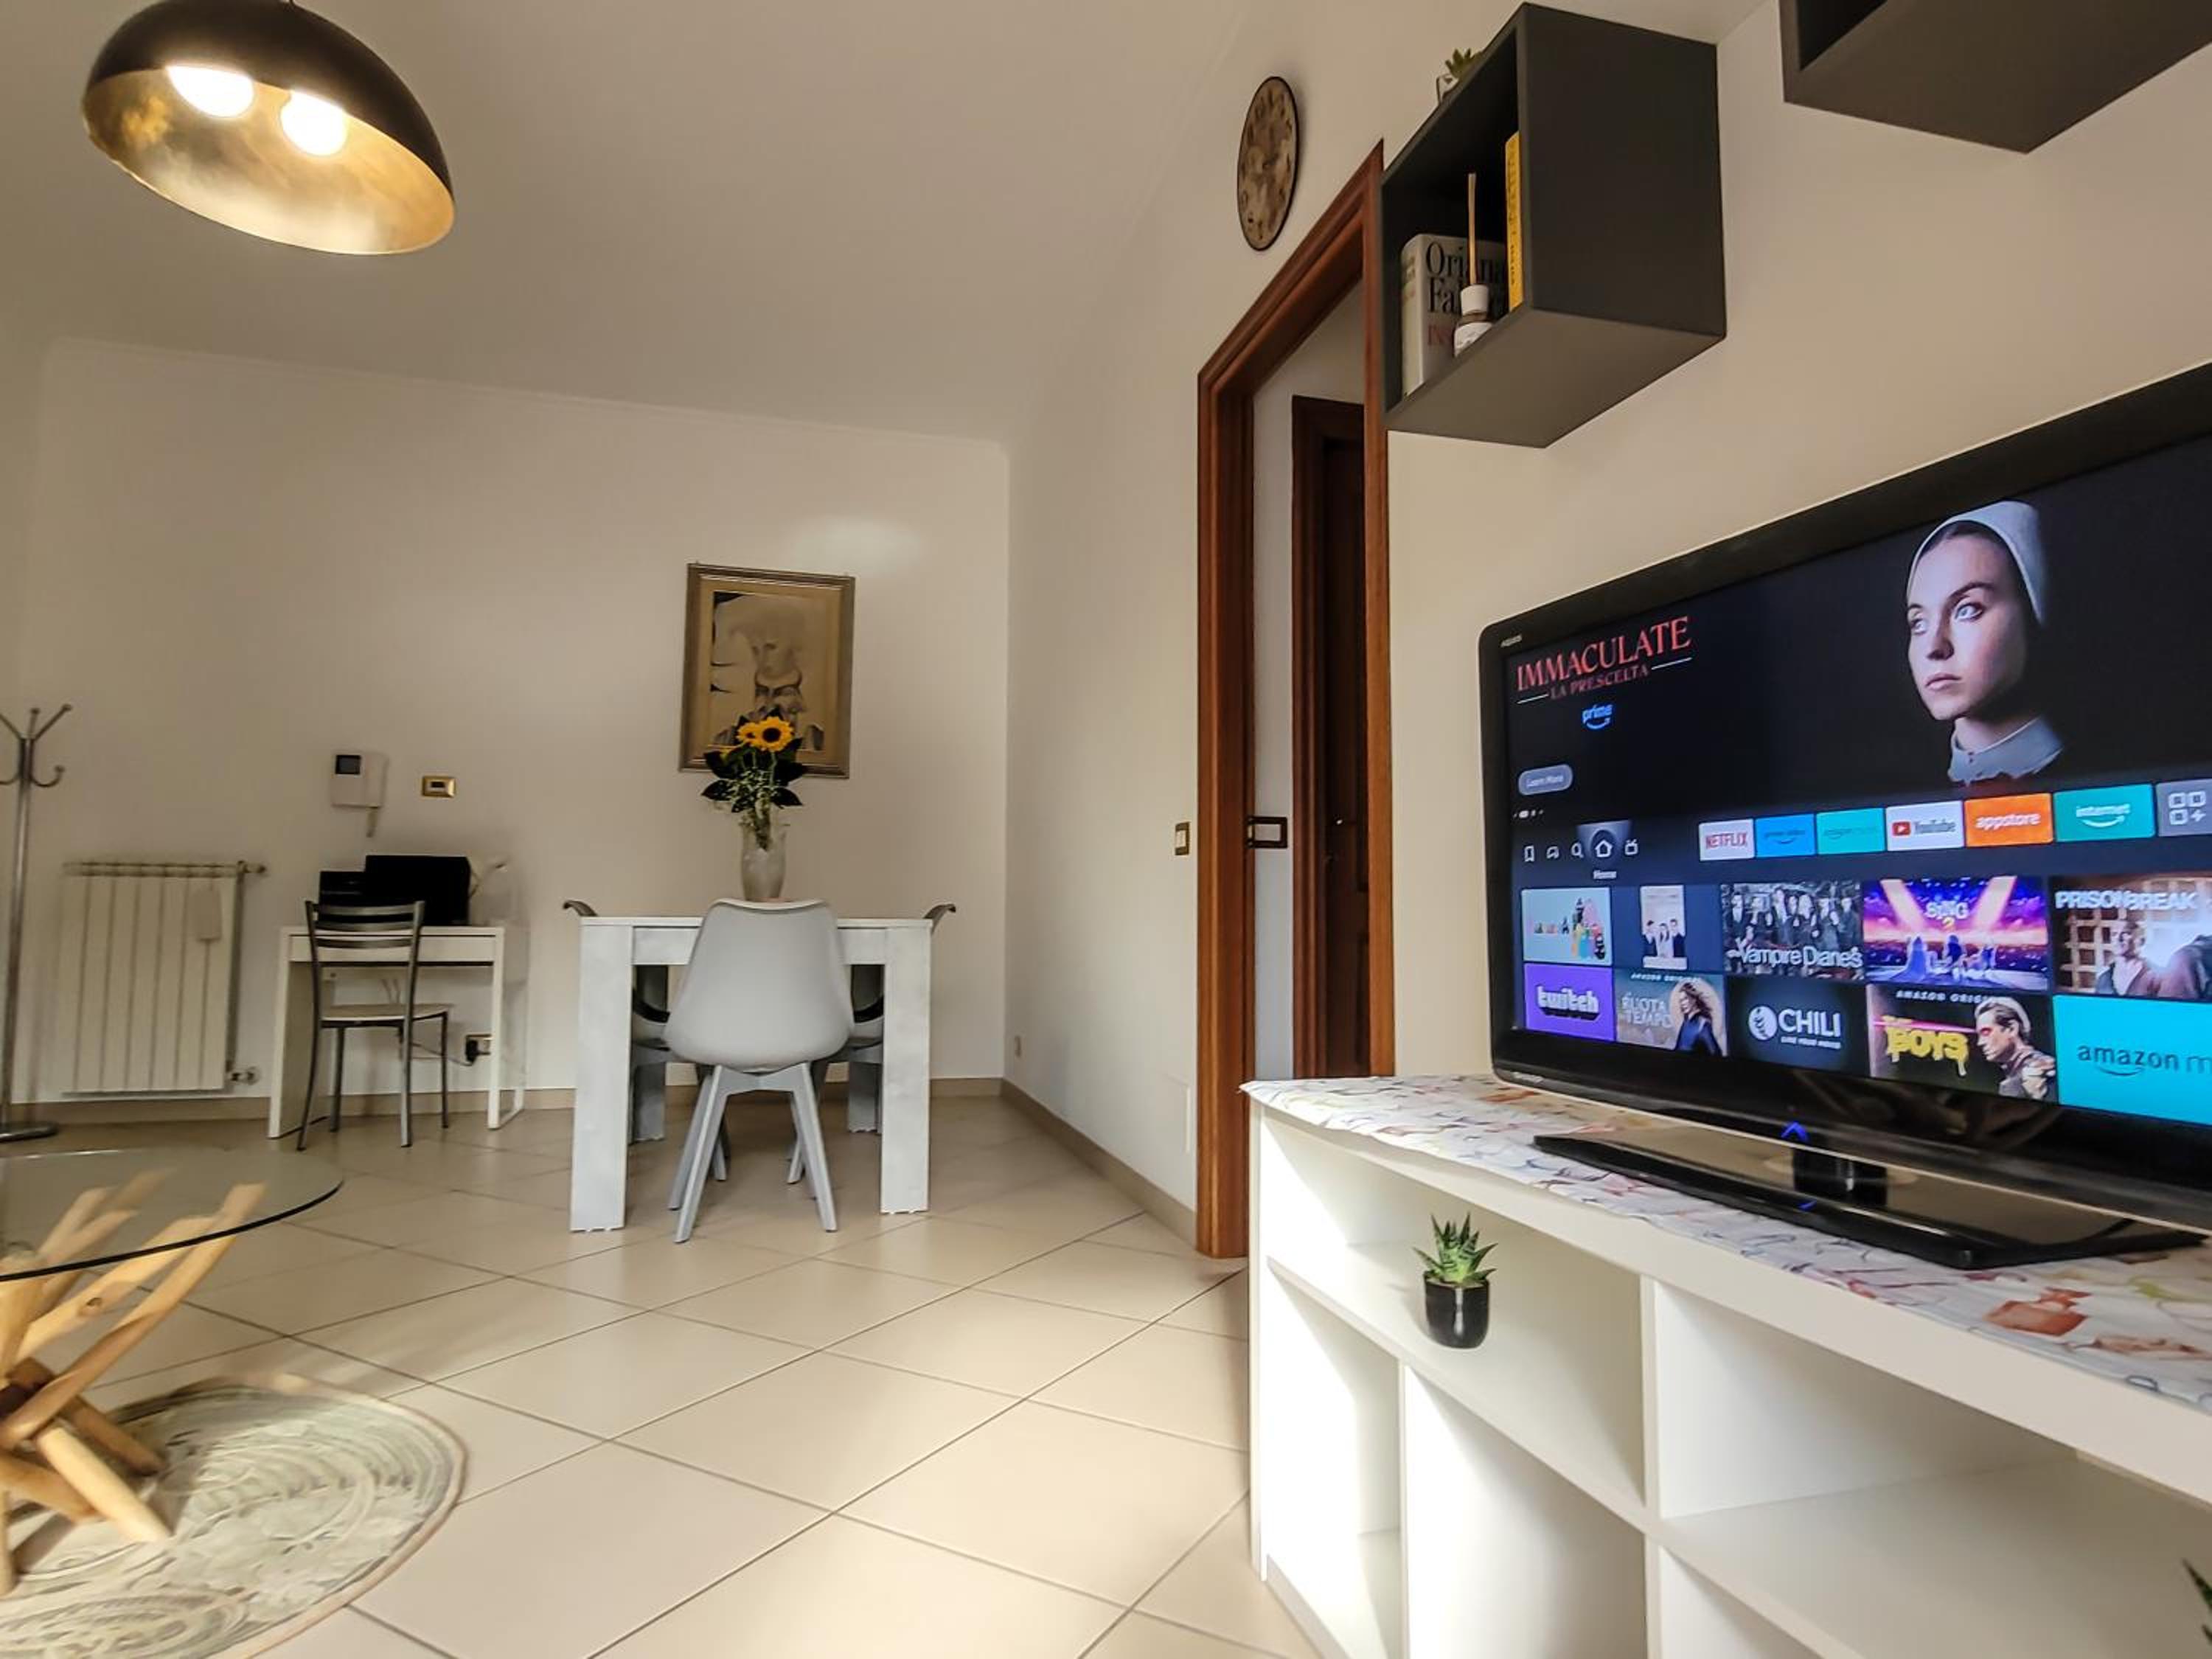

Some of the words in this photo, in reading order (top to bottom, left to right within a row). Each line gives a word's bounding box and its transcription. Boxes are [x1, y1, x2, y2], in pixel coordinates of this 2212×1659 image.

[1517, 616, 1692, 692] IMMACULATE
[1550, 684, 1567, 700] LA
[1571, 665, 1649, 694] PRESCELTA
[1582, 704, 1613, 723] prime
[1976, 813, 2041, 831] appstore
[1705, 832, 1747, 849] NETFLIX
[1536, 985, 1599, 1014] twitch
[1621, 995, 1667, 1014] RUOTA
[1627, 1009, 1672, 1028] TEMPO
[1778, 1008, 1841, 1037] CHILI
[1885, 1026, 1969, 1071] BOYS
[2077, 1045, 2179, 1070] amazon
[2186, 1055, 2212, 1074] m
